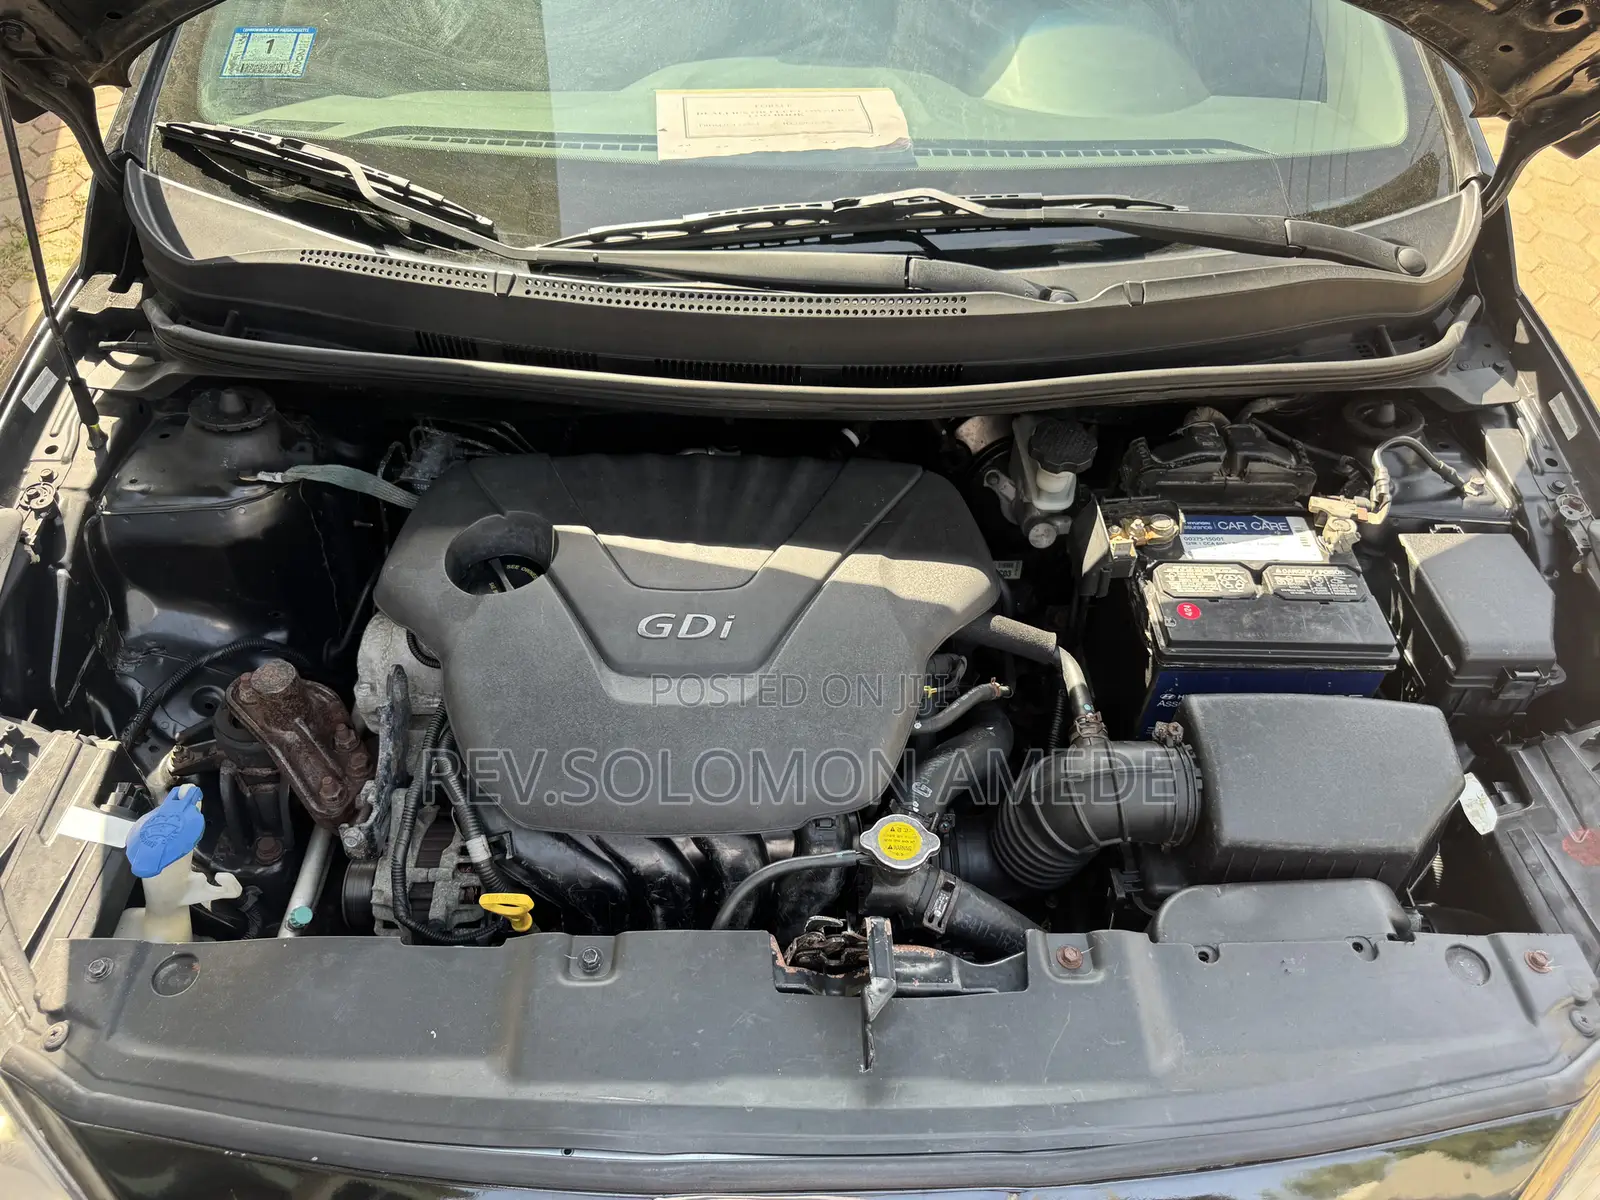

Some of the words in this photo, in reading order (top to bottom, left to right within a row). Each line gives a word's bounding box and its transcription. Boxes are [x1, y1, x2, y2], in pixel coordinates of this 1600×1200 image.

[266, 38, 275, 54] 1
[1217, 521, 1248, 531] CAR
[1250, 521, 1290, 531] CARE
[637, 613, 736, 640] GDi
